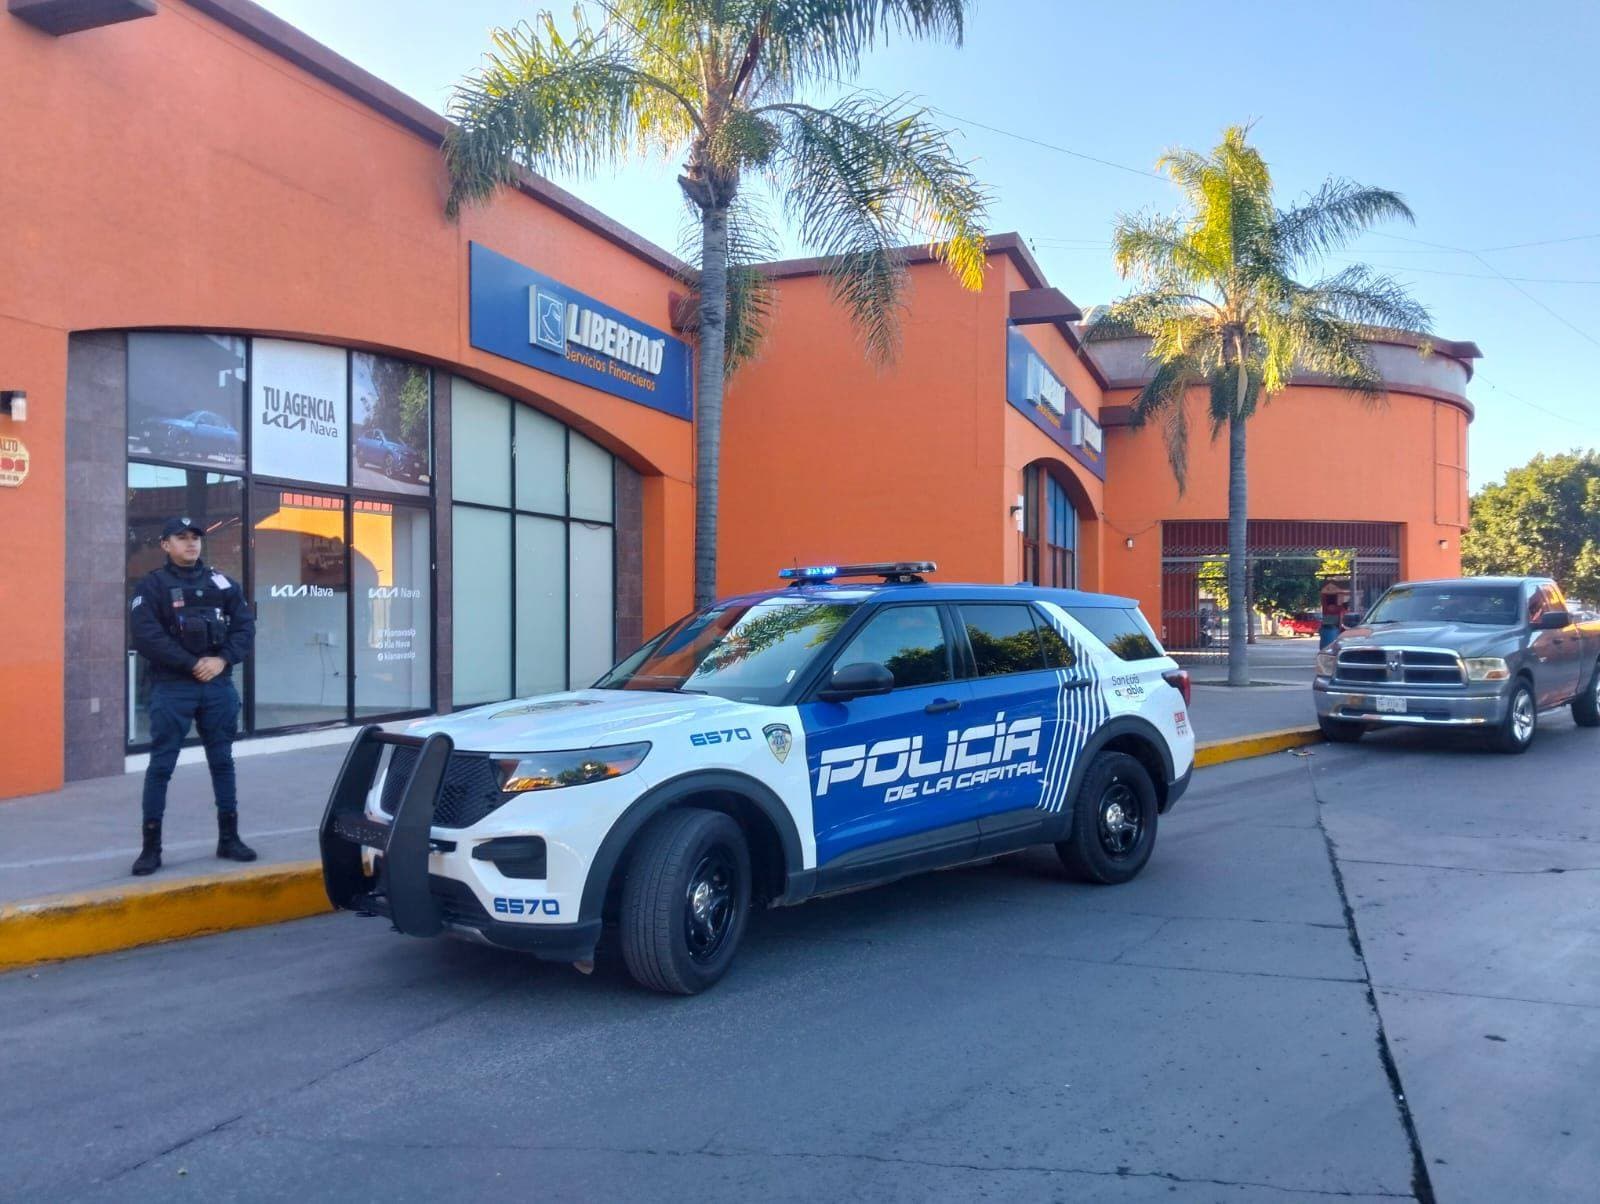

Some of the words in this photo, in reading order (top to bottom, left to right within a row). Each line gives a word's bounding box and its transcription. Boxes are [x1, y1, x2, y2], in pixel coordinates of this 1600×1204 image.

[566, 303, 664, 375] LIBERTAD
[565, 344, 606, 373] Servicios
[608, 360, 656, 391] Financieros
[263, 386, 280, 412] TU
[283, 391, 336, 424] AGENCIA
[262, 411, 306, 432] KIA
[310, 420, 338, 438] Nava
[271, 584, 308, 598] KIA
[310, 585, 334, 598] Nava
[401, 587, 420, 598] Nava
[690, 728, 752, 746] 6570
[816, 711, 1042, 797] POLICÍA
[884, 783, 919, 803] DE
[922, 776, 953, 795] LA
[955, 760, 1043, 789] CAPITAL
[494, 897, 560, 915] 6570
